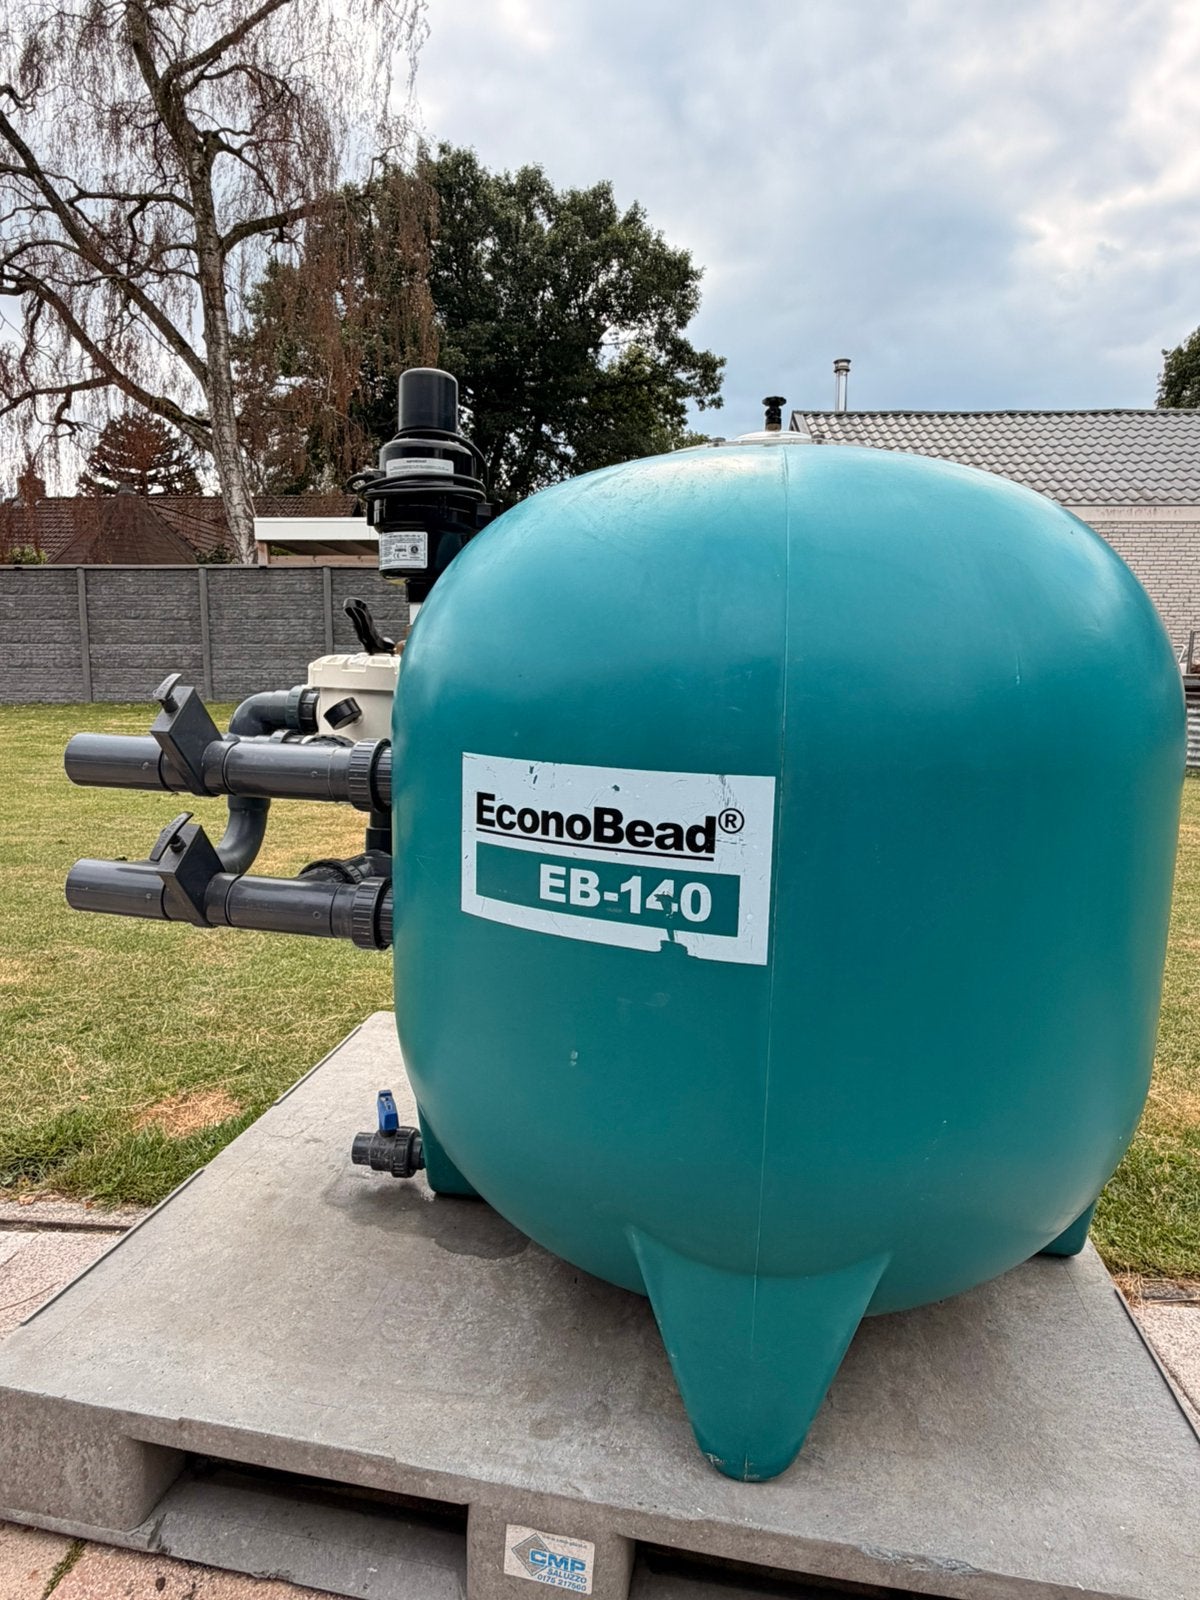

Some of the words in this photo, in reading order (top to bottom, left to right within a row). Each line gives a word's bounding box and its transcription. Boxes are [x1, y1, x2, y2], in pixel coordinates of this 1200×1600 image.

[539, 863, 712, 922] EB-140
[530, 1550, 586, 1573] CMP
[537, 1574, 556, 1584] 0175
[547, 1568, 588, 1584] SALUZZO
